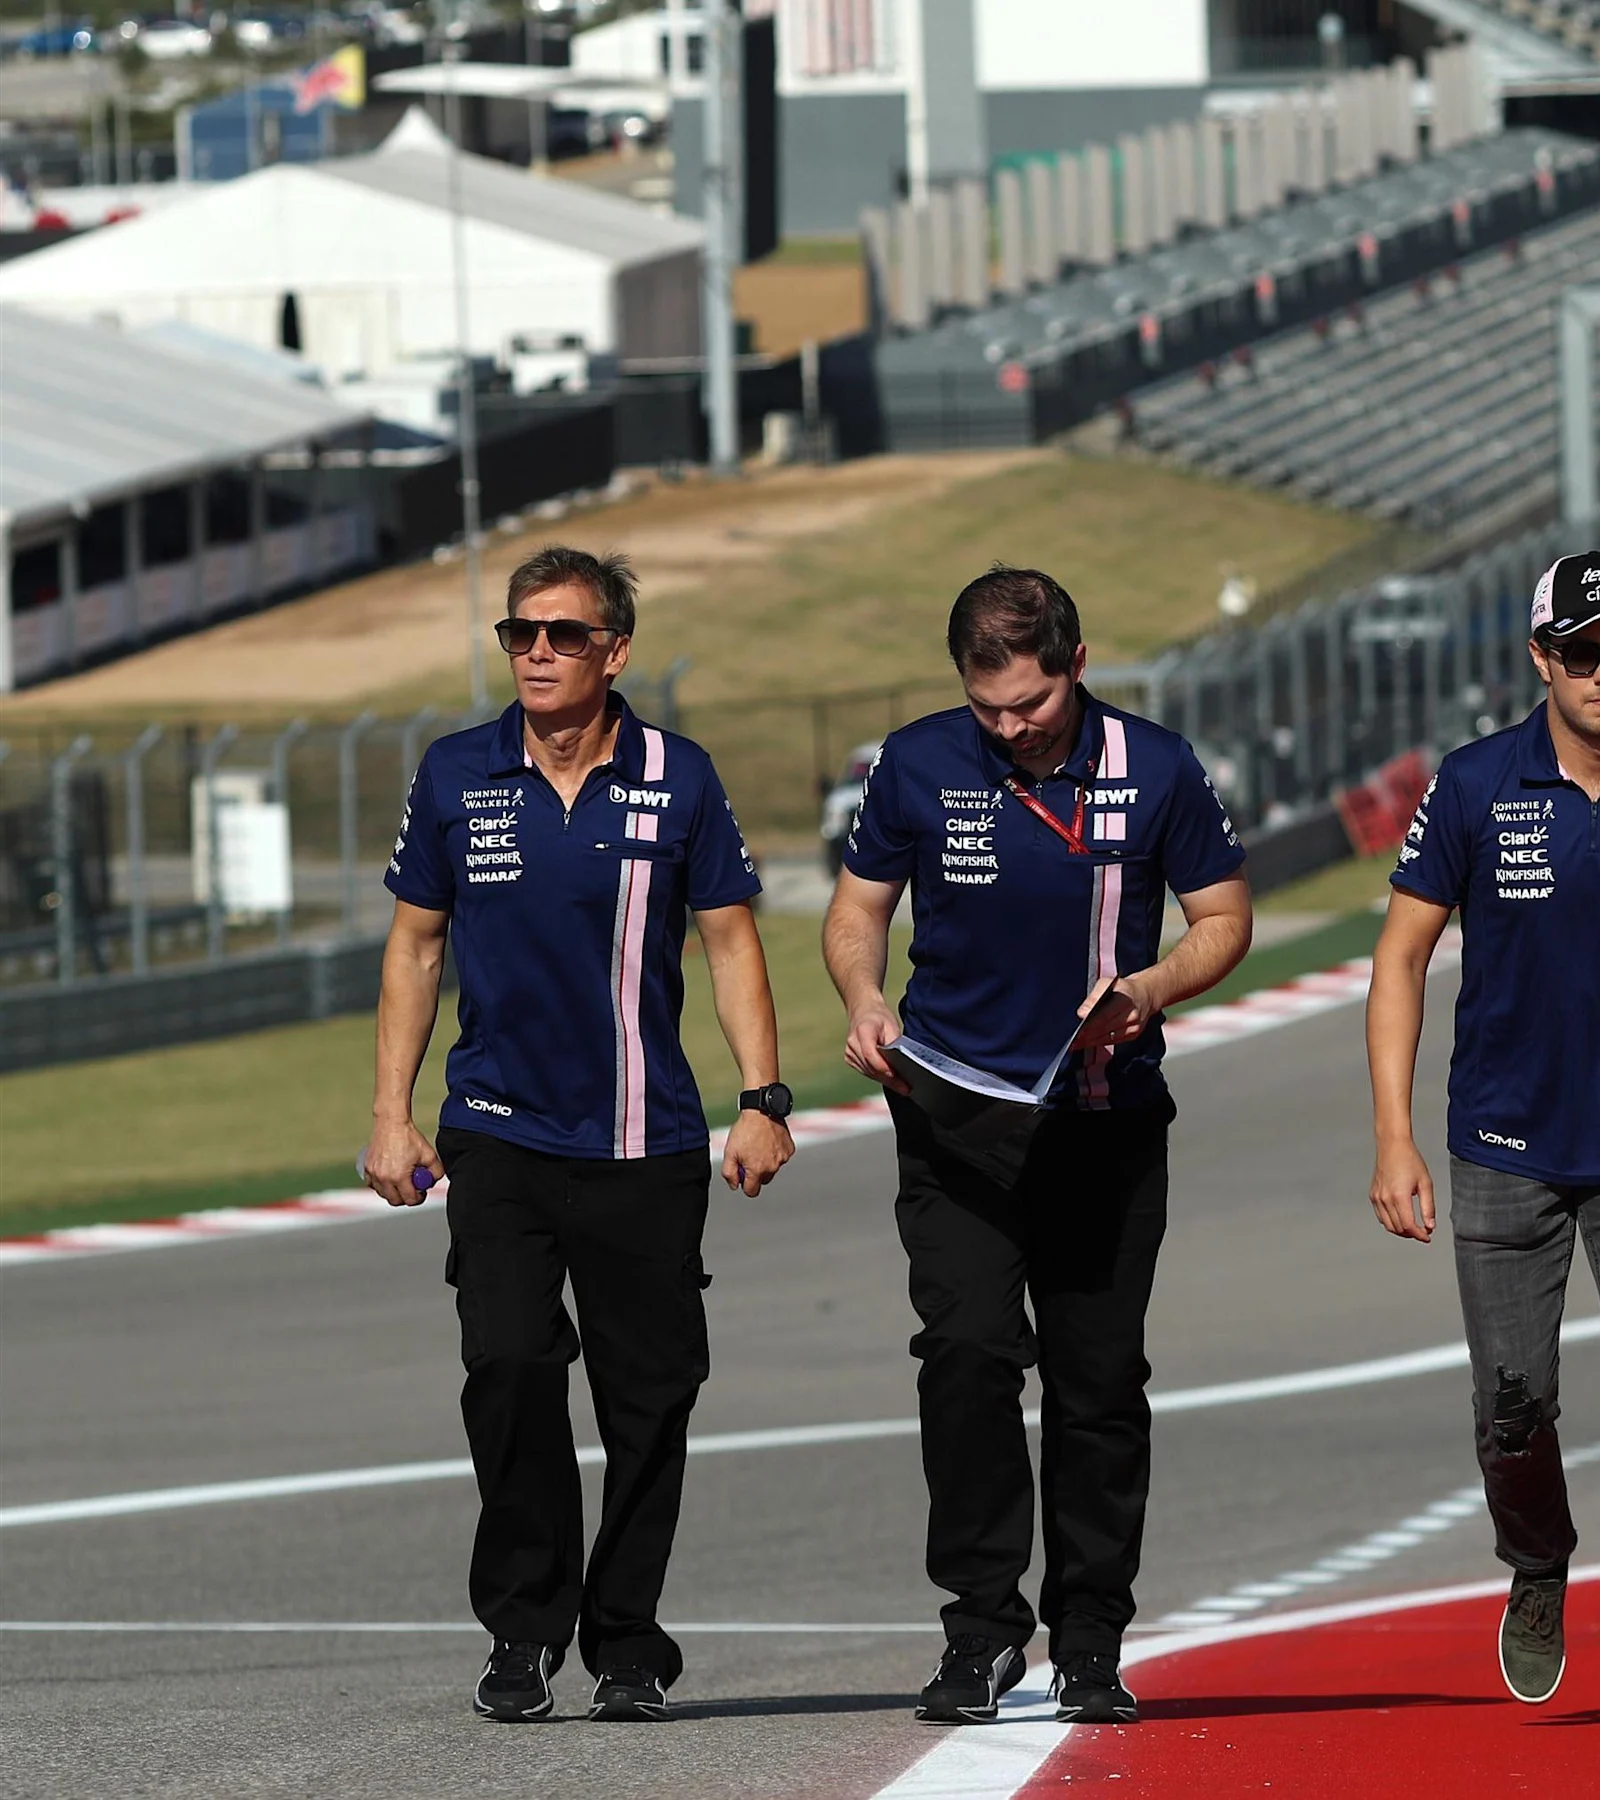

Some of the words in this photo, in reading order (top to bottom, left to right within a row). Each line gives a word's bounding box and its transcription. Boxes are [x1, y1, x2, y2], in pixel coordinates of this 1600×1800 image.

[461, 789, 509, 802] JOHNNIE
[628, 789, 672, 808] BWT
[939, 788, 989, 800] JOHNNIE
[1094, 788, 1139, 805] BWT
[465, 799, 509, 810] WALKER
[943, 799, 988, 809] WALKER
[1491, 801, 1540, 814] JOHNNIE
[469, 814, 513, 831] Claro
[946, 815, 990, 832] Claro
[1494, 812, 1540, 822] WALKER
[1408, 822, 1425, 841] PE
[1498, 829, 1545, 846] Claro
[470, 834, 516, 849] NEC
[947, 836, 993, 850] NEC
[466, 851, 523, 868] KINGFISHER
[941, 853, 999, 869] KINGFISHER
[1500, 849, 1548, 864] NEC
[468, 870, 517, 883] SAHARA
[943, 871, 993, 884] SAHARA
[1495, 867, 1555, 883] KINGFISHER
[1498, 888, 1549, 899] SAHARA
